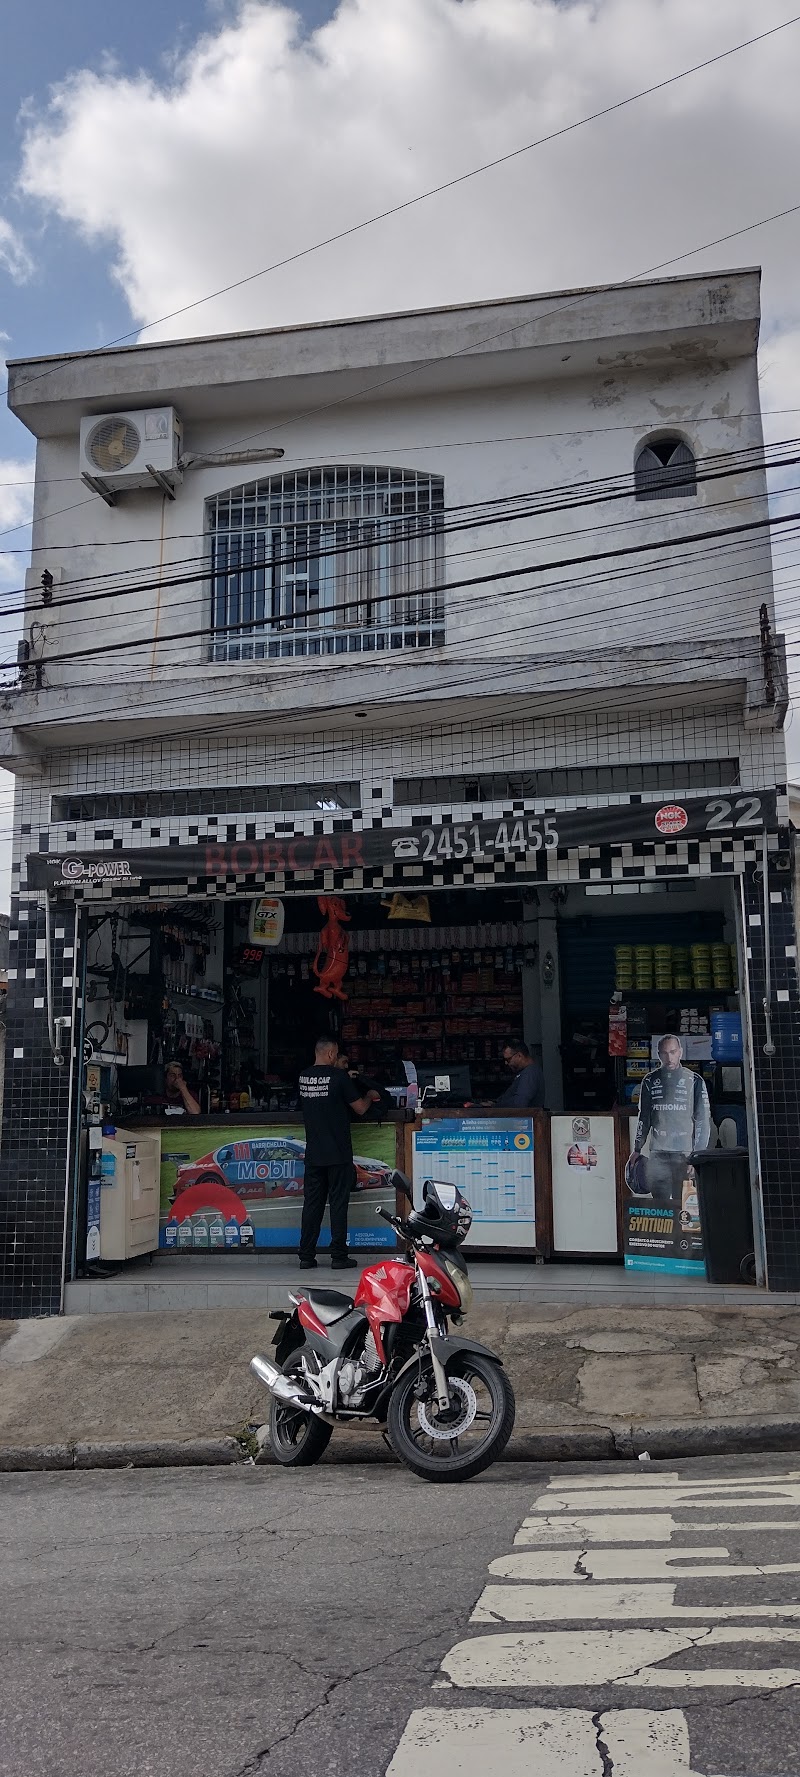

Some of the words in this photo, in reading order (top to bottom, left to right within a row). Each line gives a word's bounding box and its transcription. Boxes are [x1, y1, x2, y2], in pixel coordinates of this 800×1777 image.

[660, 811, 682, 820] NGK
[705, 797, 763, 830] 22
[421, 817, 559, 861] 2451-4455
[205, 832, 366, 876] BOBCAR
[61, 857, 131, 879] G-POWER
[53, 879, 81, 887] PLATINUM
[243, 949, 263, 961] 998
[652, 1103, 687, 1111] PETRONAS
[233, 1142, 251, 1160] 111
[251, 1141, 287, 1149] BARRICHELLO
[237, 1160, 296, 1180] Mobil
[628, 1207, 674, 1217] PETRONAS
[628, 1216, 674, 1234] SYNTIUM
